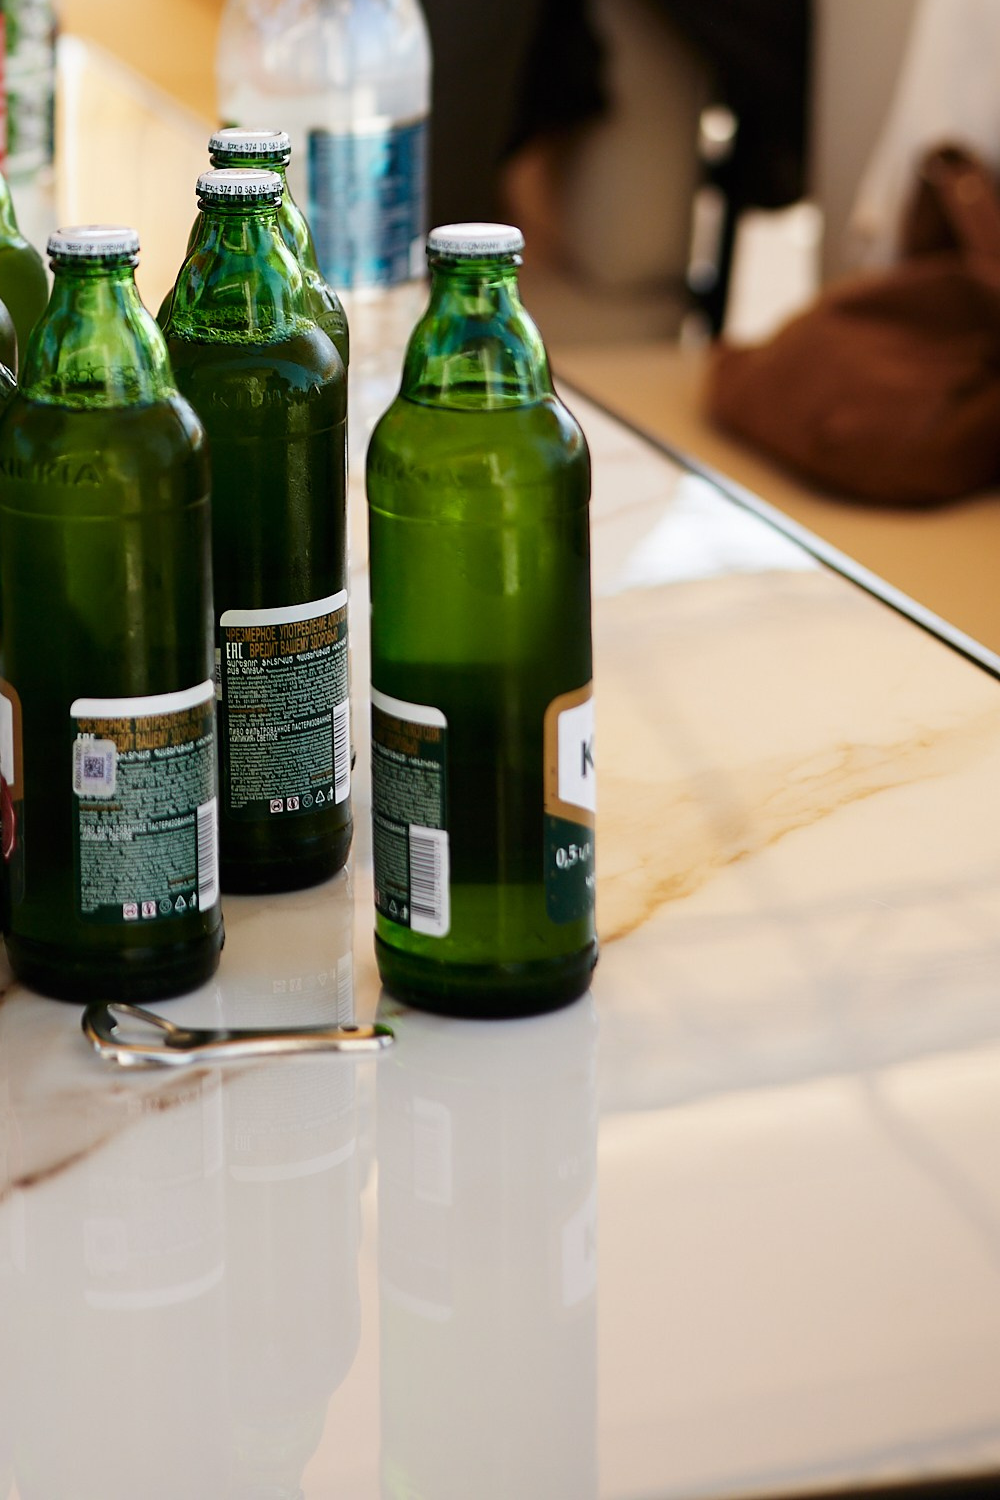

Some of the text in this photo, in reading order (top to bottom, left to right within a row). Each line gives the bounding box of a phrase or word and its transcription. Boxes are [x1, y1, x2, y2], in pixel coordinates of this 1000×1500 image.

[234, 185, 243, 194] 10
[226, 626, 276, 643] ЧРЕЗМЕРНОЕ
[250, 642, 278, 658] ВРЕДИТ
[280, 636, 309, 655] ВАШЕМУ
